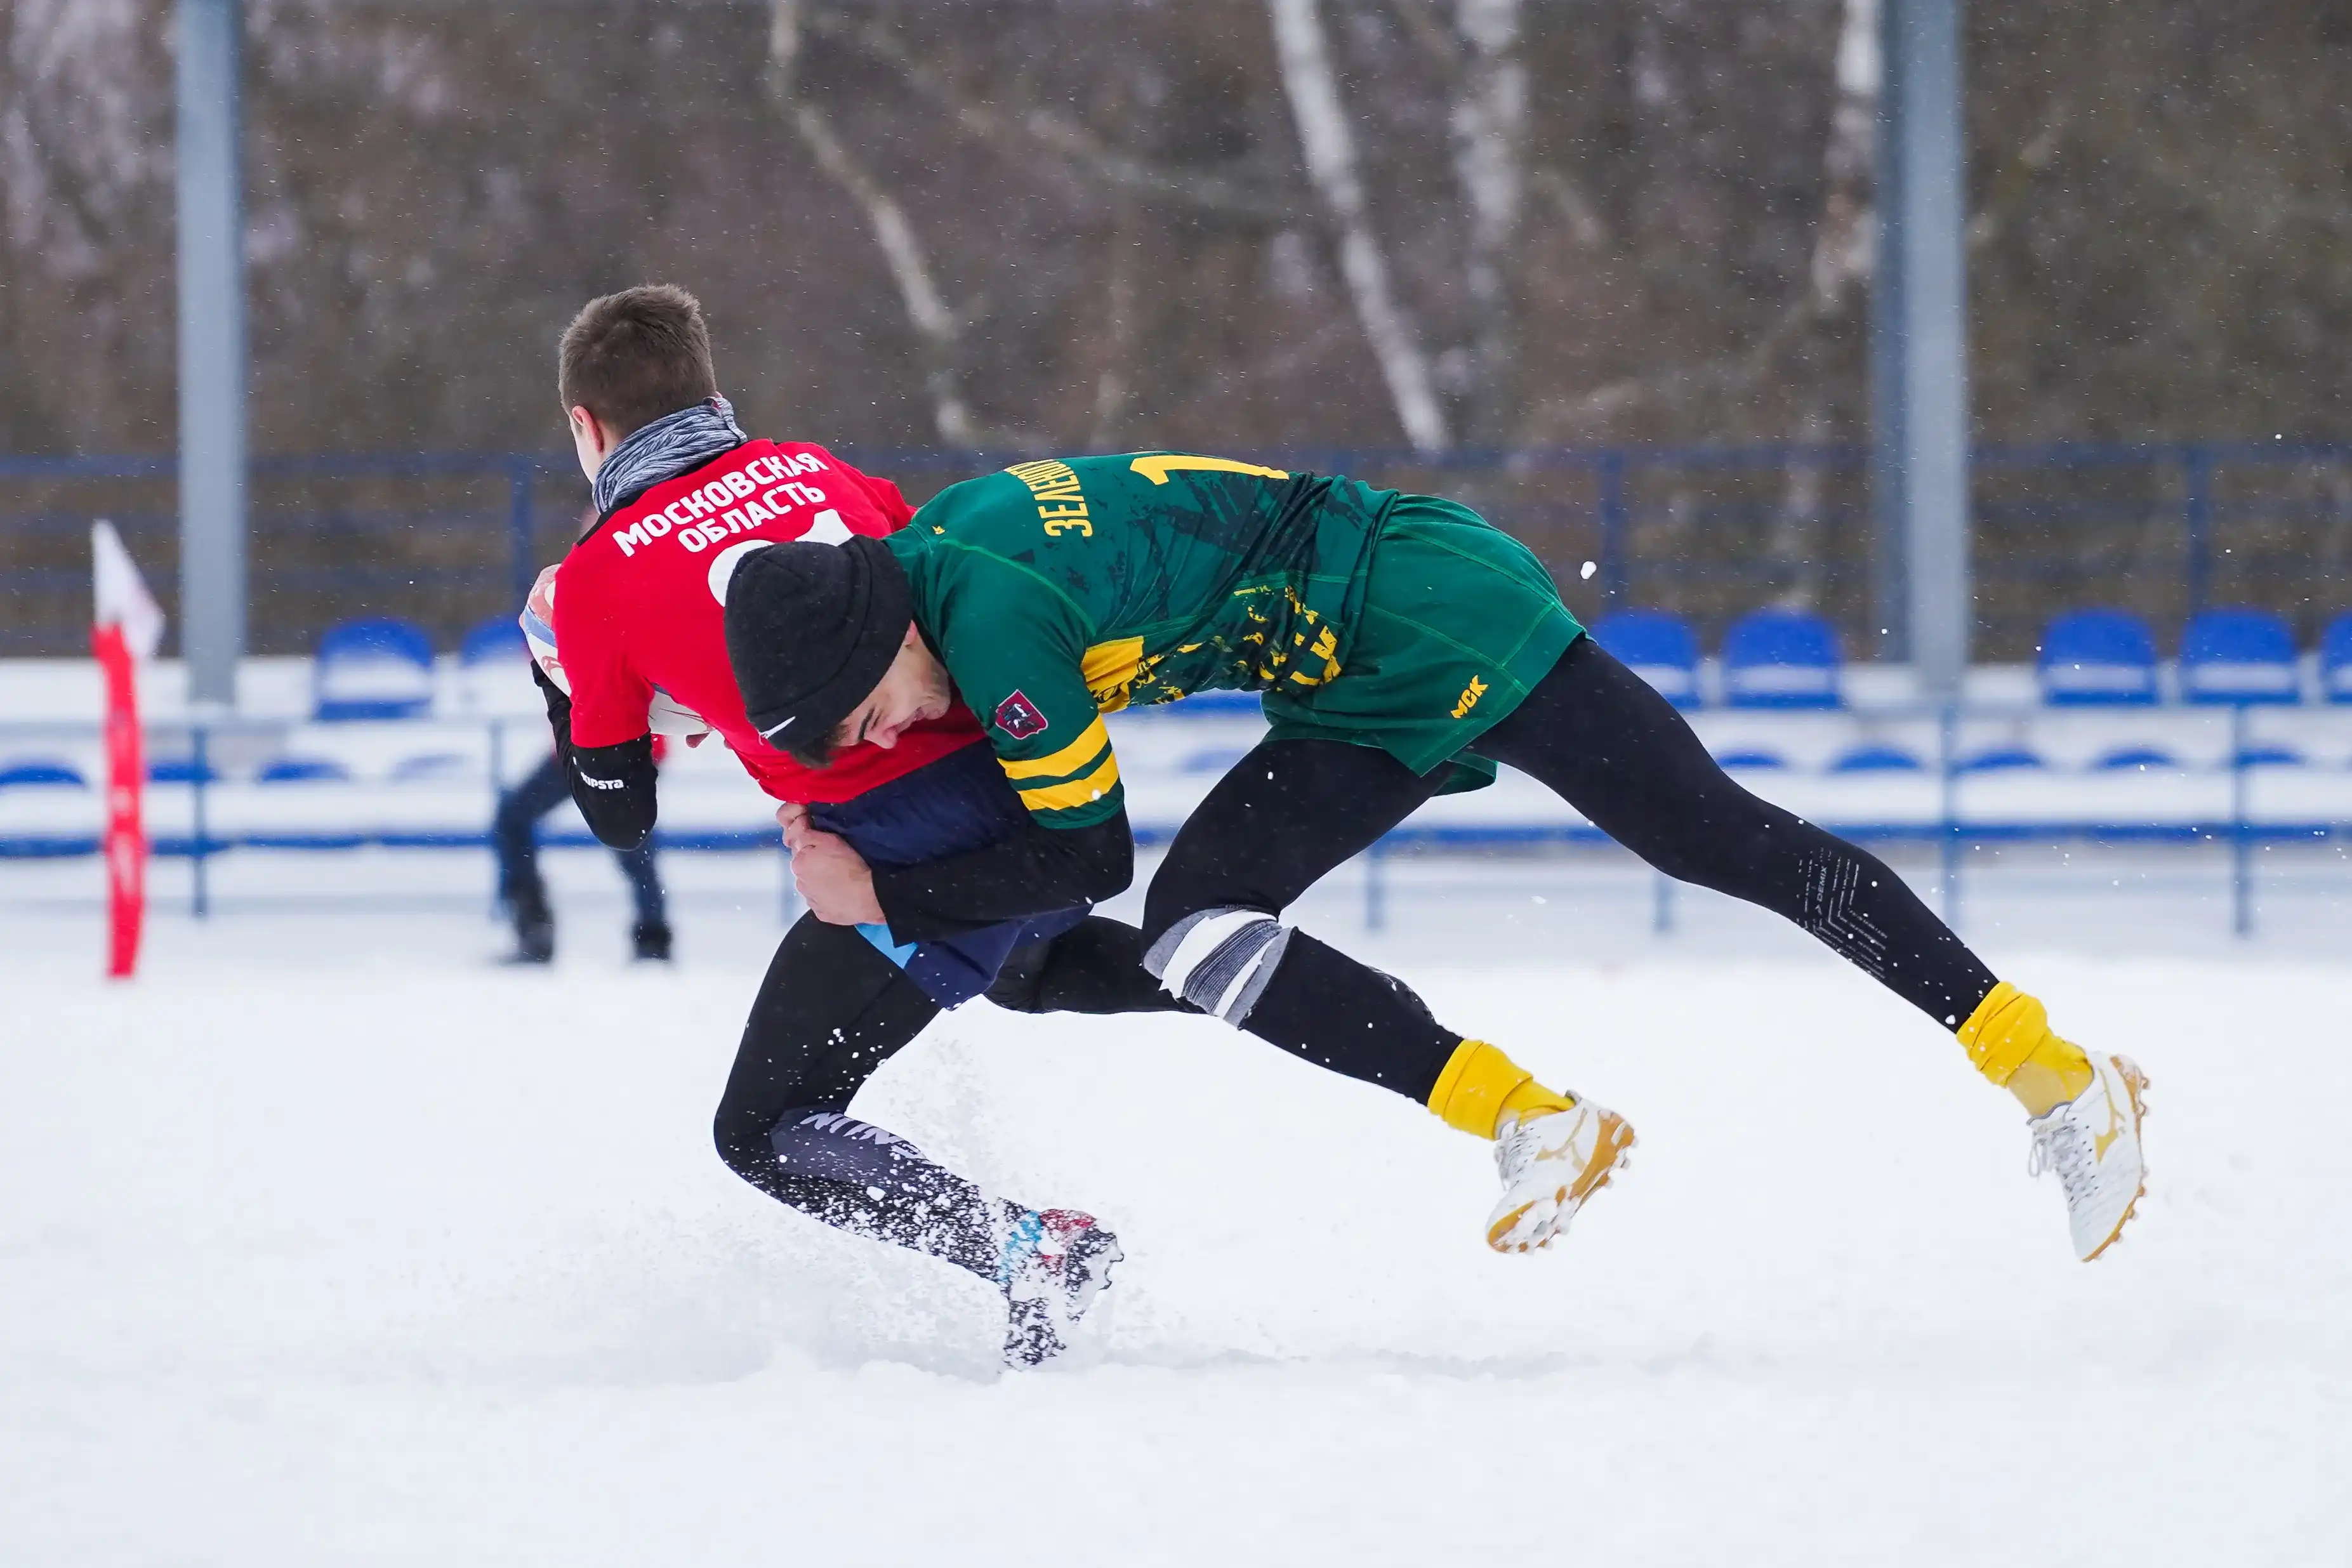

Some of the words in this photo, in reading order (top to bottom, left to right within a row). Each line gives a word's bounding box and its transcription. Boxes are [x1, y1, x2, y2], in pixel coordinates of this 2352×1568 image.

[612, 452, 829, 557] МОСКОВСКАЯ
[677, 482, 826, 553] ОБЛАСТЬ
[1816, 866, 1827, 902] DEMIX
